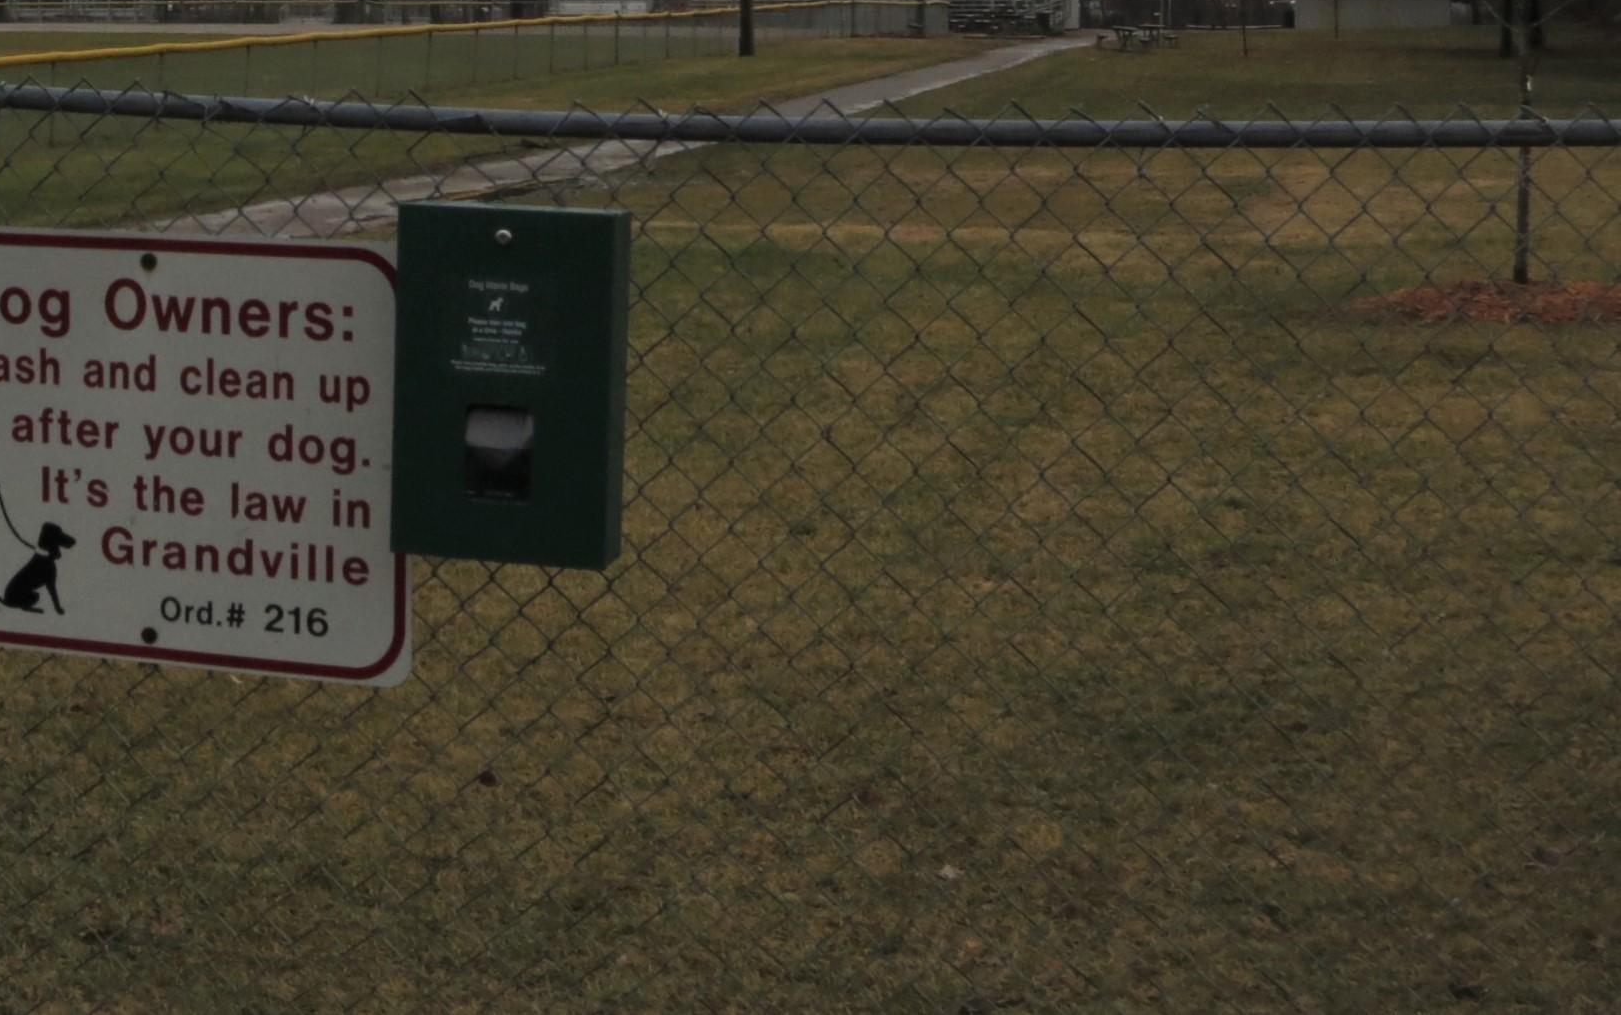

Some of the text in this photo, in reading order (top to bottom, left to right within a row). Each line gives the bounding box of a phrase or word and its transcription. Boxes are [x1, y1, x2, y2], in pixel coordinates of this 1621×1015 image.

[103, 277, 355, 343] Owners:
[82, 353, 157, 393] and
[179, 357, 295, 402] clean
[318, 373, 372, 414] up
[11, 406, 372, 476] after your dog.
[41, 465, 372, 530] It's the law in
[100, 525, 371, 587] Grandville
[159, 595, 329, 638] Ord.# 216
